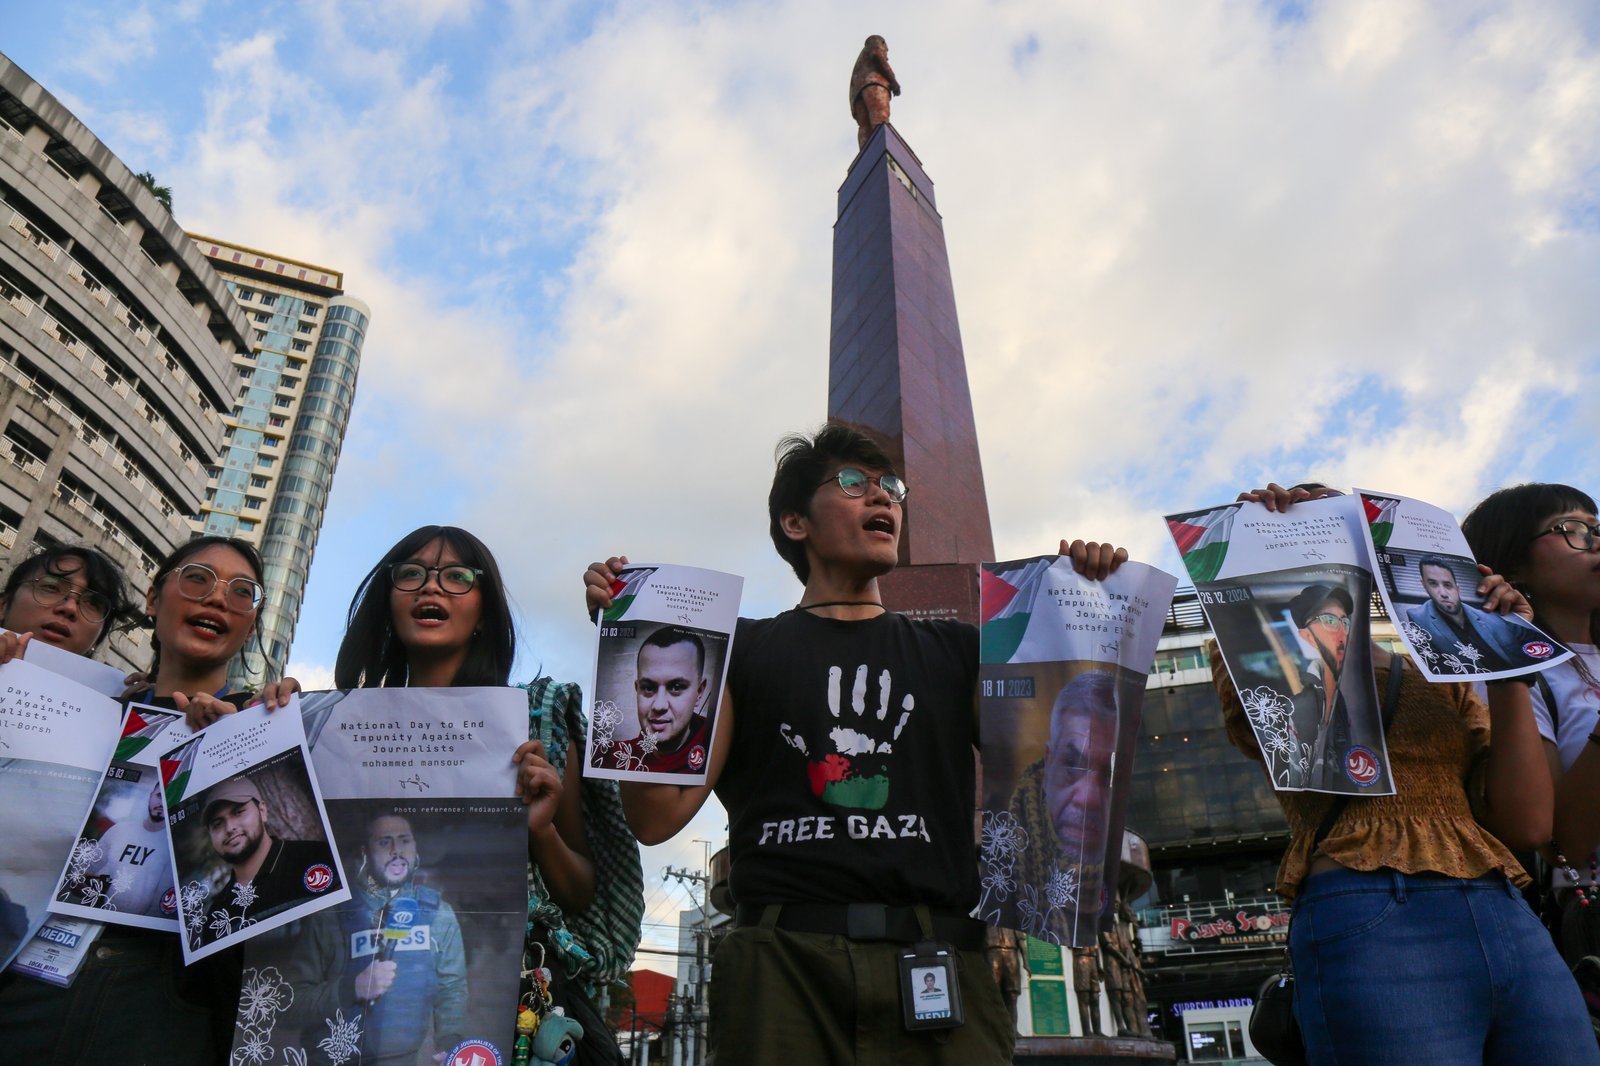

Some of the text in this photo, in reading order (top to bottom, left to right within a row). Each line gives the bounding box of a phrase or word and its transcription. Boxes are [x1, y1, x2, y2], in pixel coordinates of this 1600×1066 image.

[1304, 522, 1341, 530] Against
[1274, 530, 1332, 539] Journalists
[656, 590, 714, 602] Impunity Against
[1048, 588, 1101, 598] National
[1109, 593, 1128, 602] Day
[1200, 588, 1250, 604] 26 12 2024
[666, 596, 705, 607] Journalists
[1058, 600, 1112, 611] Impunity
[602, 627, 608, 637] 31
[610, 627, 618, 637] 03
[1066, 624, 1108, 632] Mostafa
[982, 680, 1032, 696] 18 11 2023
[7, 686, 82, 713] Day to End
[16, 699, 69, 718] Against
[340, 720, 485, 730] National Day to End
[170, 731, 189, 739] Natio
[202, 738, 231, 755] National
[234, 732, 245, 740] Day
[260, 720, 272, 728] End
[353, 732, 473, 742] Impunity Against
[208, 728, 266, 758] Impunity Against
[218, 738, 258, 759] Journalists
[372, 745, 455, 754] Journalists
[362, 758, 465, 768] mohammed mansour
[108, 767, 115, 777] 15
[115, 768, 124, 779] 03
[178, 809, 186, 821] 03
[394, 806, 522, 814] Photo reference: Mediapart.fr
[758, 814, 931, 846] FREE GAZA
[119, 844, 156, 866] FLY
[1236, 911, 1292, 931] STONE
[38, 928, 77, 947] MEDIA
[356, 930, 426, 952] PRSS
[1220, 934, 1265, 944] BILLIARDS
[28, 960, 60, 973] LOCAL MEDIA
[460, 1039, 494, 1050] JOURNALISTS
